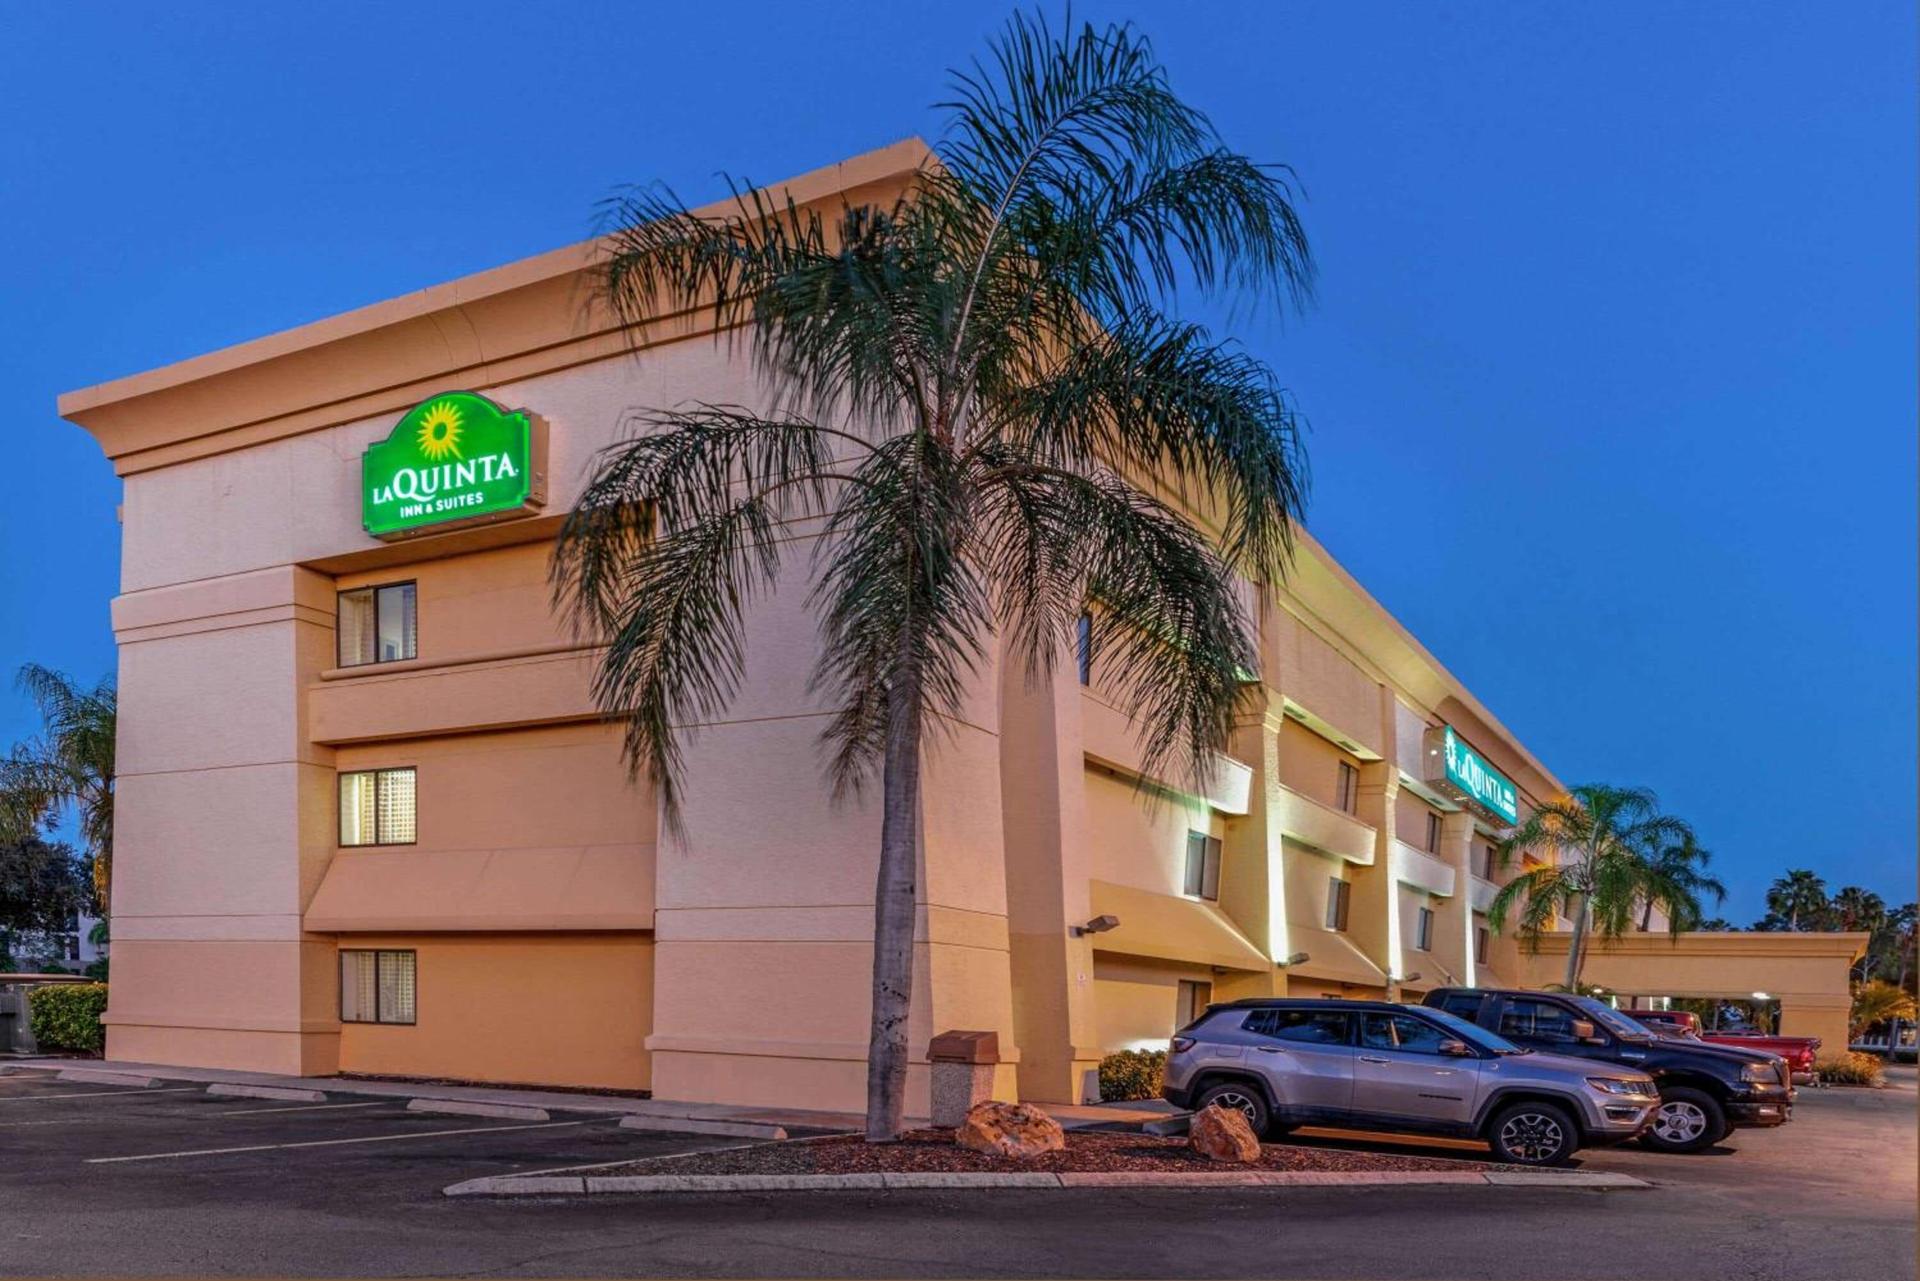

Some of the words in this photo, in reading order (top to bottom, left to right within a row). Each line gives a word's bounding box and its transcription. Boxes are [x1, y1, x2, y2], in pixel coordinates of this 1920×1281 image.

[373, 486, 393, 504] LA
[392, 452, 517, 502] QUINTA
[400, 504, 423, 518] INN
[426, 503, 433, 514] &
[436, 492, 484, 512] SUITES
[1465, 753, 1504, 808] QUINTA
